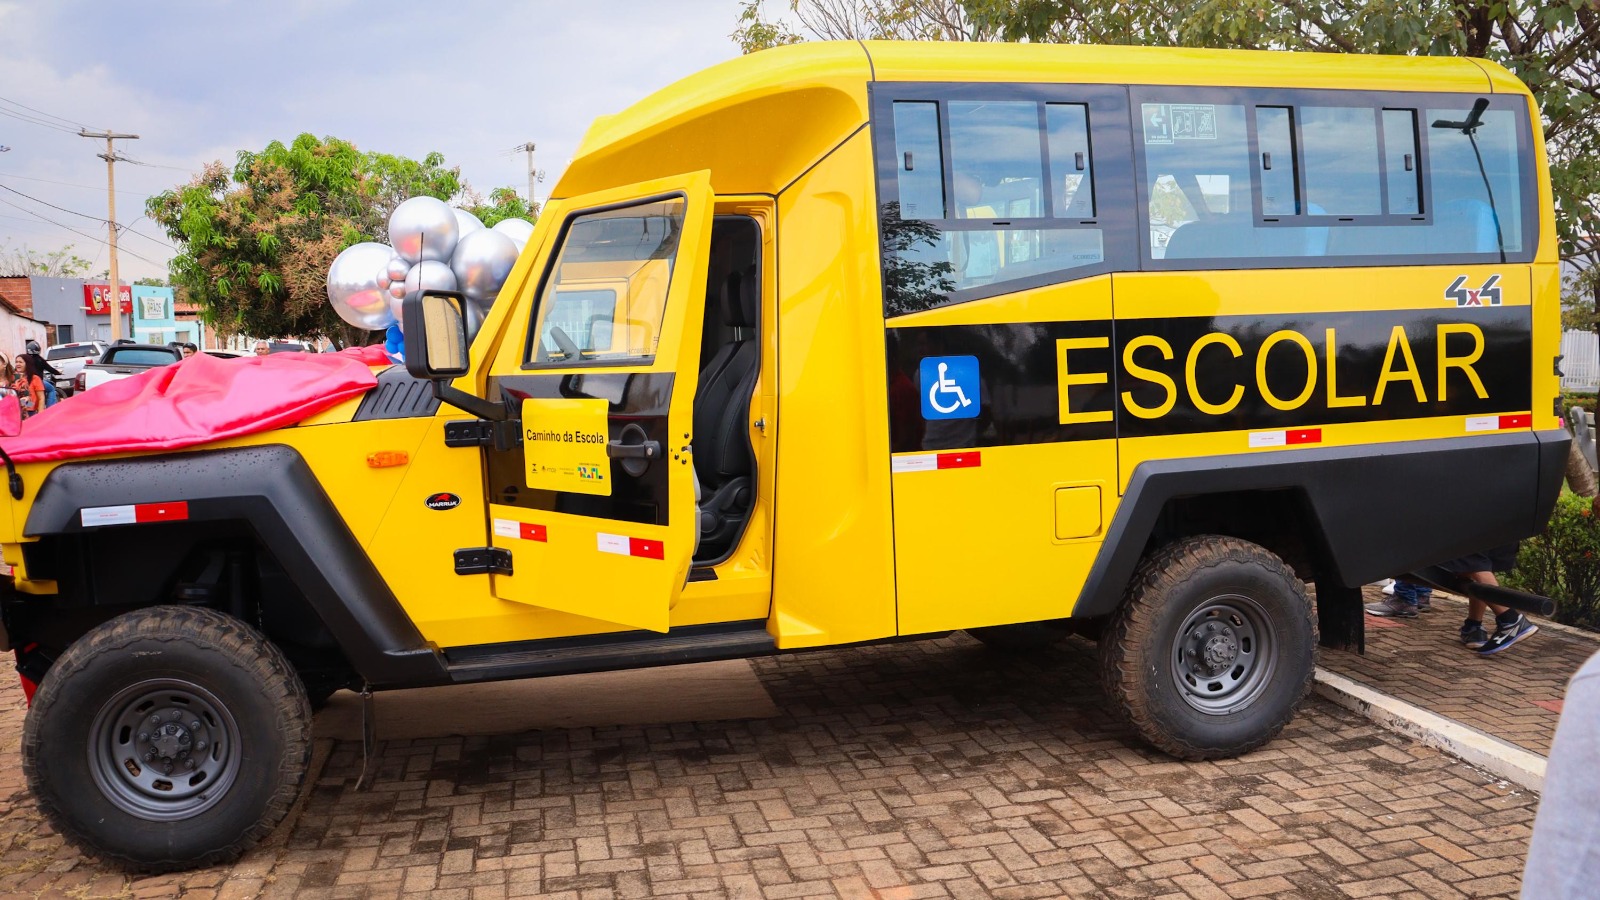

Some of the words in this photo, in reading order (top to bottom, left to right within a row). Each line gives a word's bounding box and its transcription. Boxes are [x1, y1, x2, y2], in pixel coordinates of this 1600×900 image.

[1445, 274, 1502, 307] 4x4
[1056, 323, 1489, 425] ESCOLAR
[526, 429, 561, 442] Caminho
[563, 431, 573, 443] da
[575, 431, 604, 444] Escola
